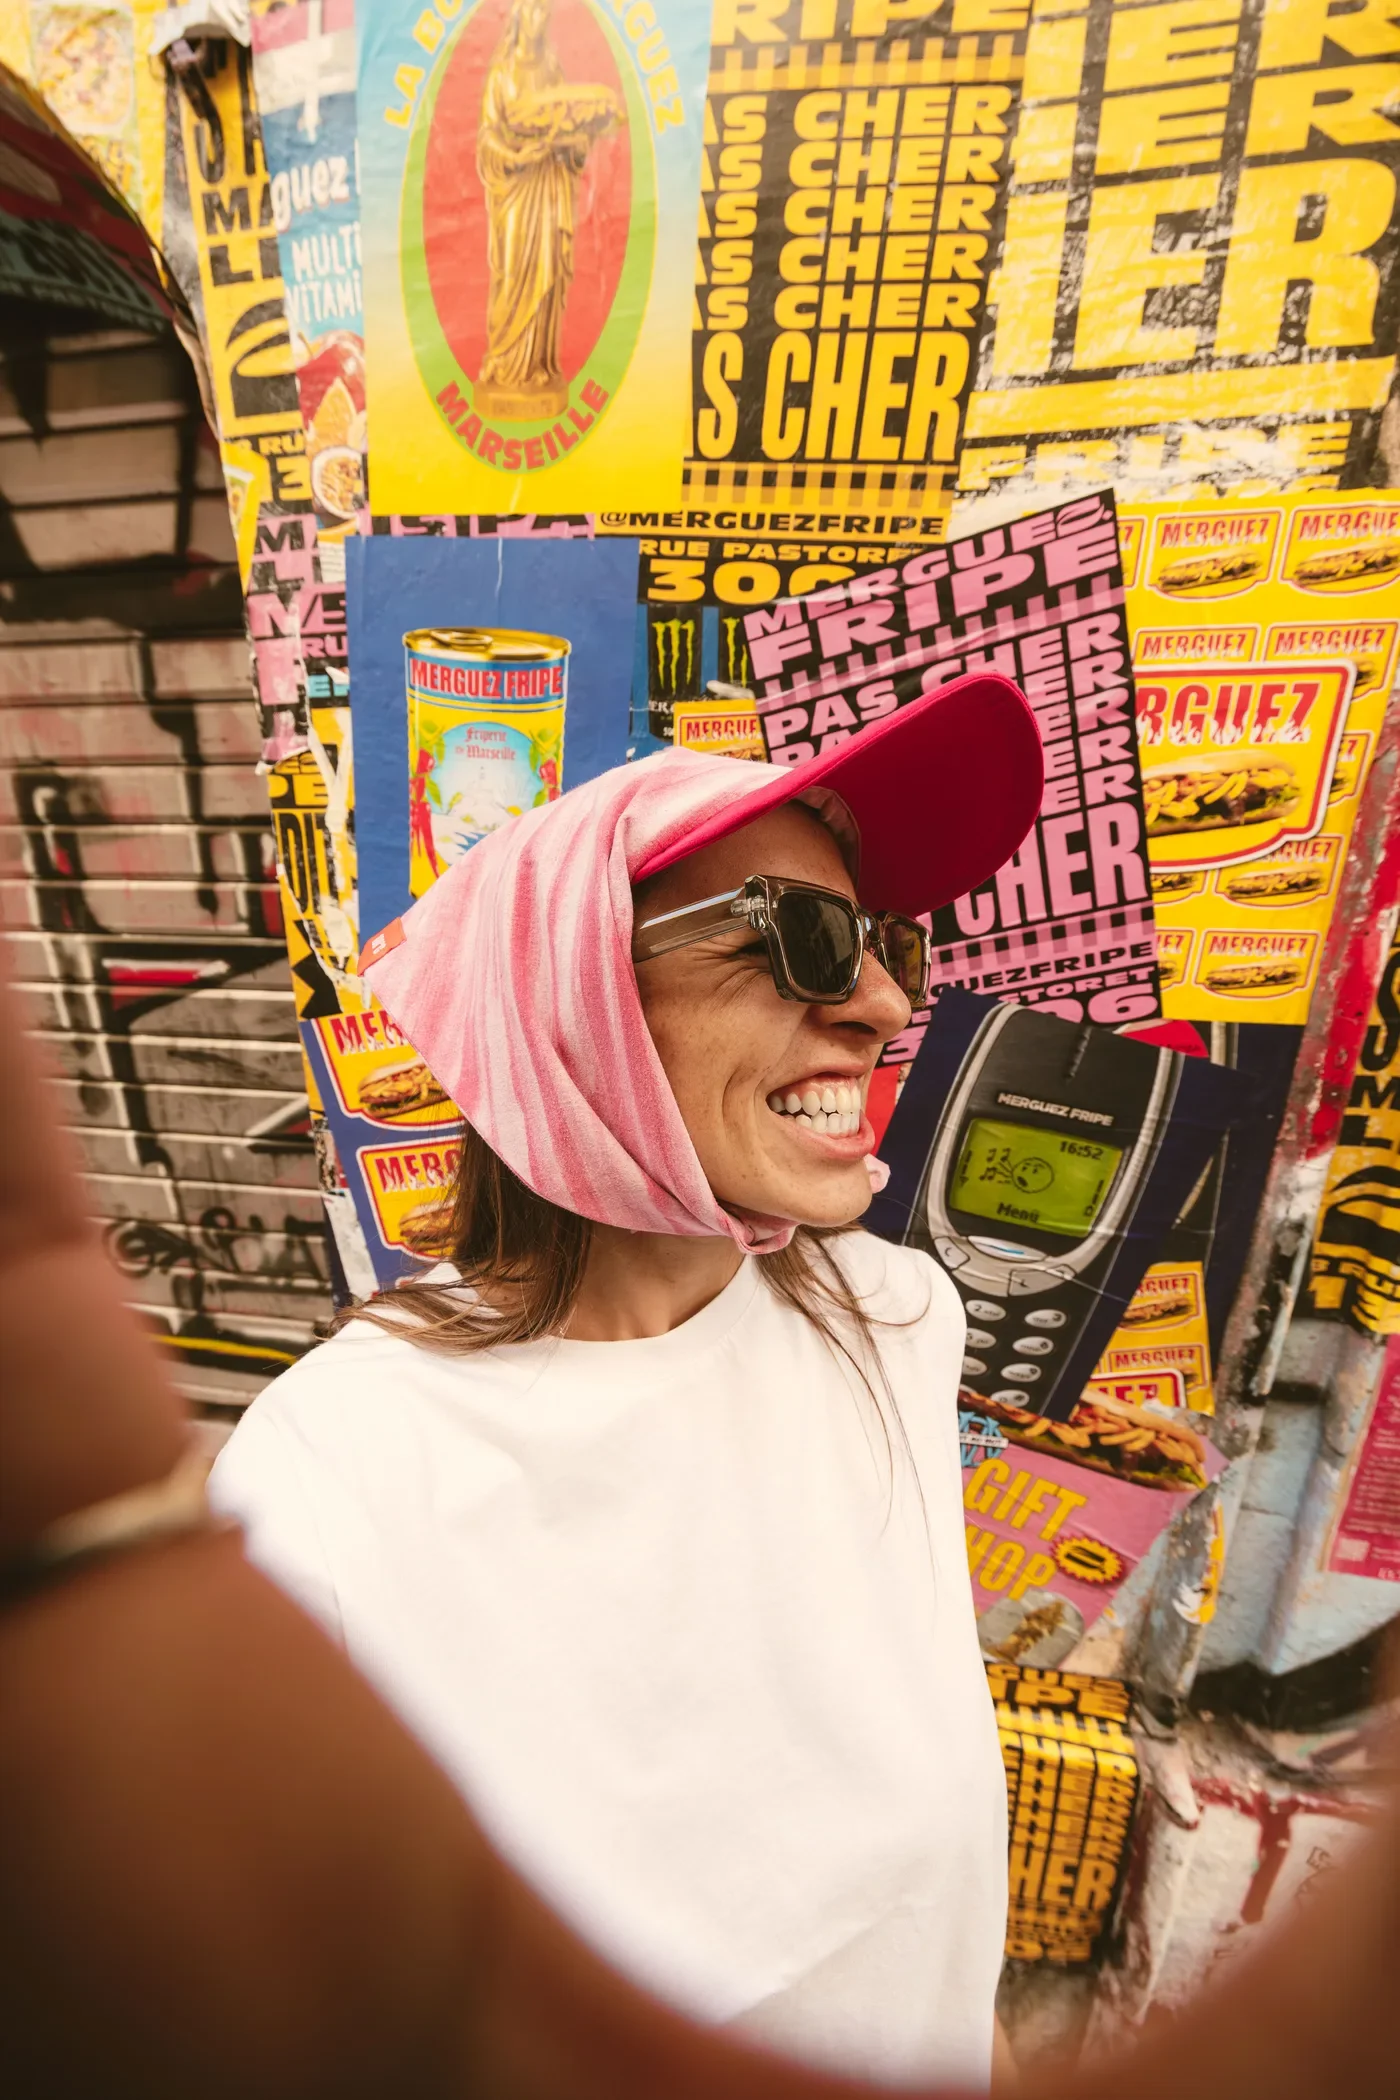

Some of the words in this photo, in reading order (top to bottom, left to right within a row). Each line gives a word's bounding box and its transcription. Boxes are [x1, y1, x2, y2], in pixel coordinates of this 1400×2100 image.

[793, 85, 1013, 140] CHER
[788, 136, 1005, 188] CHER
[783, 184, 997, 236] CHER
[778, 233, 988, 283] CHER
[773, 283, 981, 329] CHER
[761, 331, 971, 461] CHER
[436, 378, 610, 471] MARSEILLE
[600, 510, 945, 536] @MERGUEZFRIPE
[1160, 517, 1270, 549] MERGUEZ
[638, 539, 710, 559] RUE
[748, 520, 1120, 681] FRIPE
[1142, 633, 1247, 661] MERGUEZ
[1274, 626, 1387, 656] MERGUEZ
[409, 658, 503, 699] MERGUEZ
[503, 666, 563, 699] FRIPE
[763, 677, 899, 749] PAS
[1208, 934, 1309, 958] MERGUEZ
[997, 1092, 1071, 1117] MERGUEZ
[1069, 1107, 1115, 1127] FRIPE
[1059, 1141, 1104, 1160] 16:52
[1114, 1348, 1197, 1371] MERGUEZ
[963, 1458, 1088, 1542] GIFT
